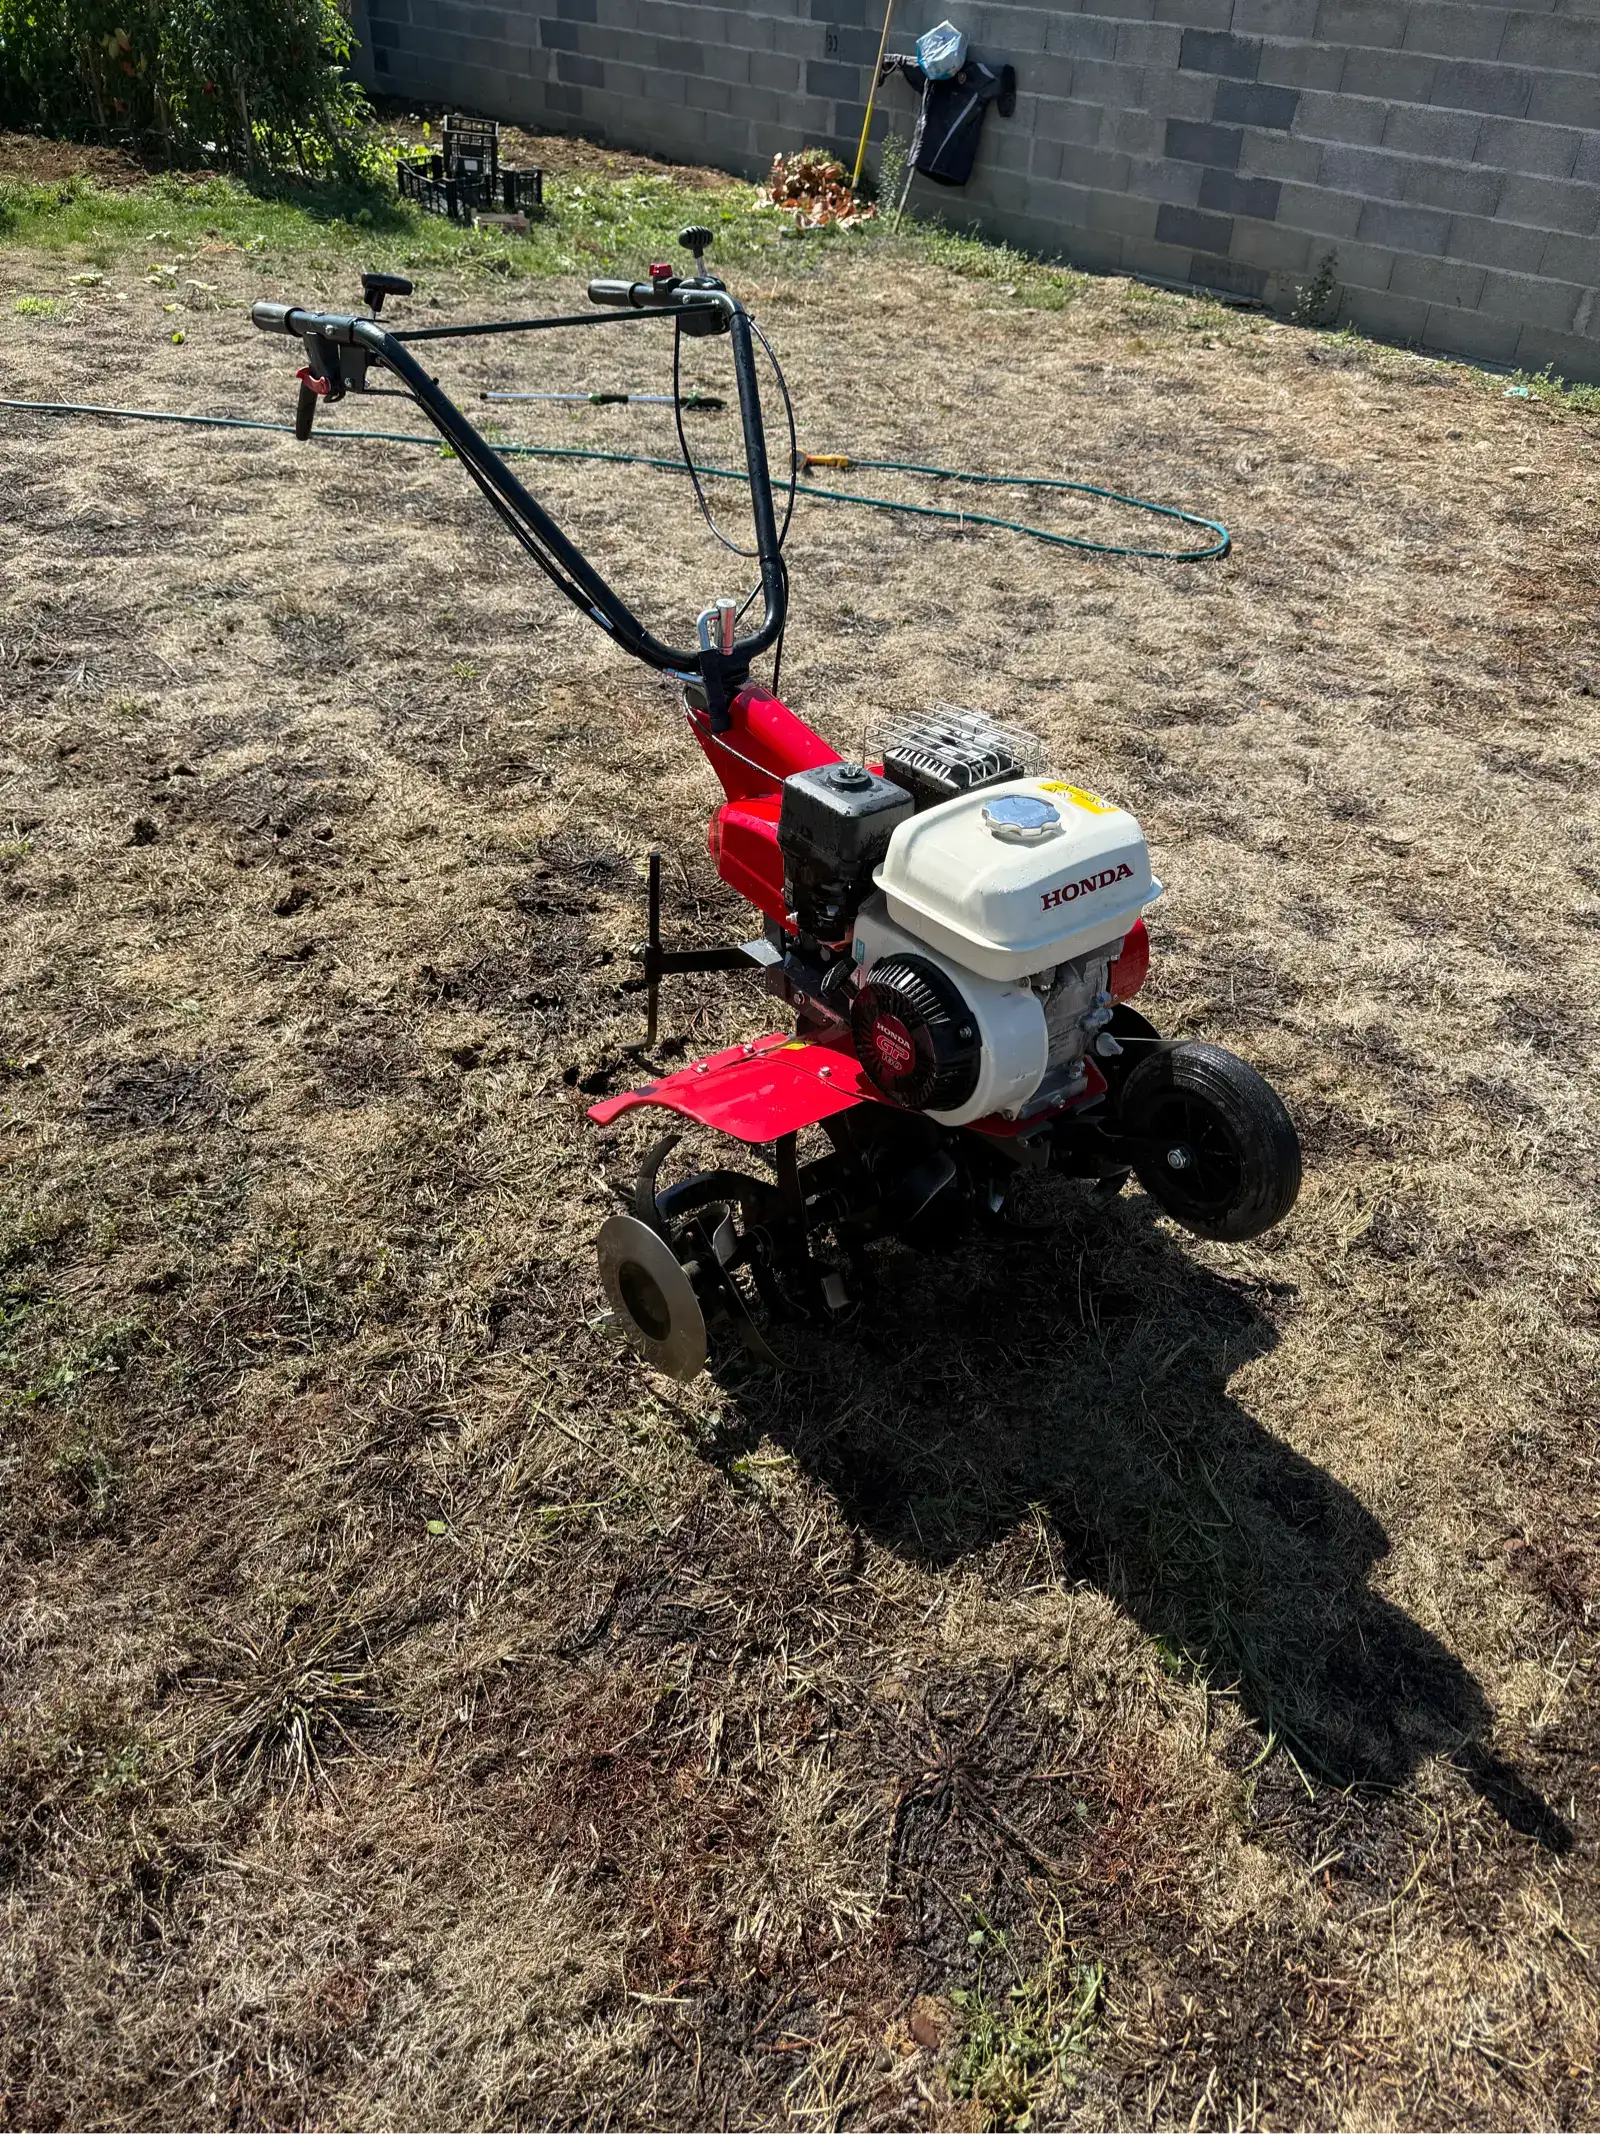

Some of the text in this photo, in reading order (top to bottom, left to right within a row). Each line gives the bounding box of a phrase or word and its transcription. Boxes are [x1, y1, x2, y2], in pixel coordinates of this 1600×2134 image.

[1041, 863, 1134, 911] HONDA
[876, 1022, 911, 1050] HONDA
[877, 1035, 909, 1060] GP
